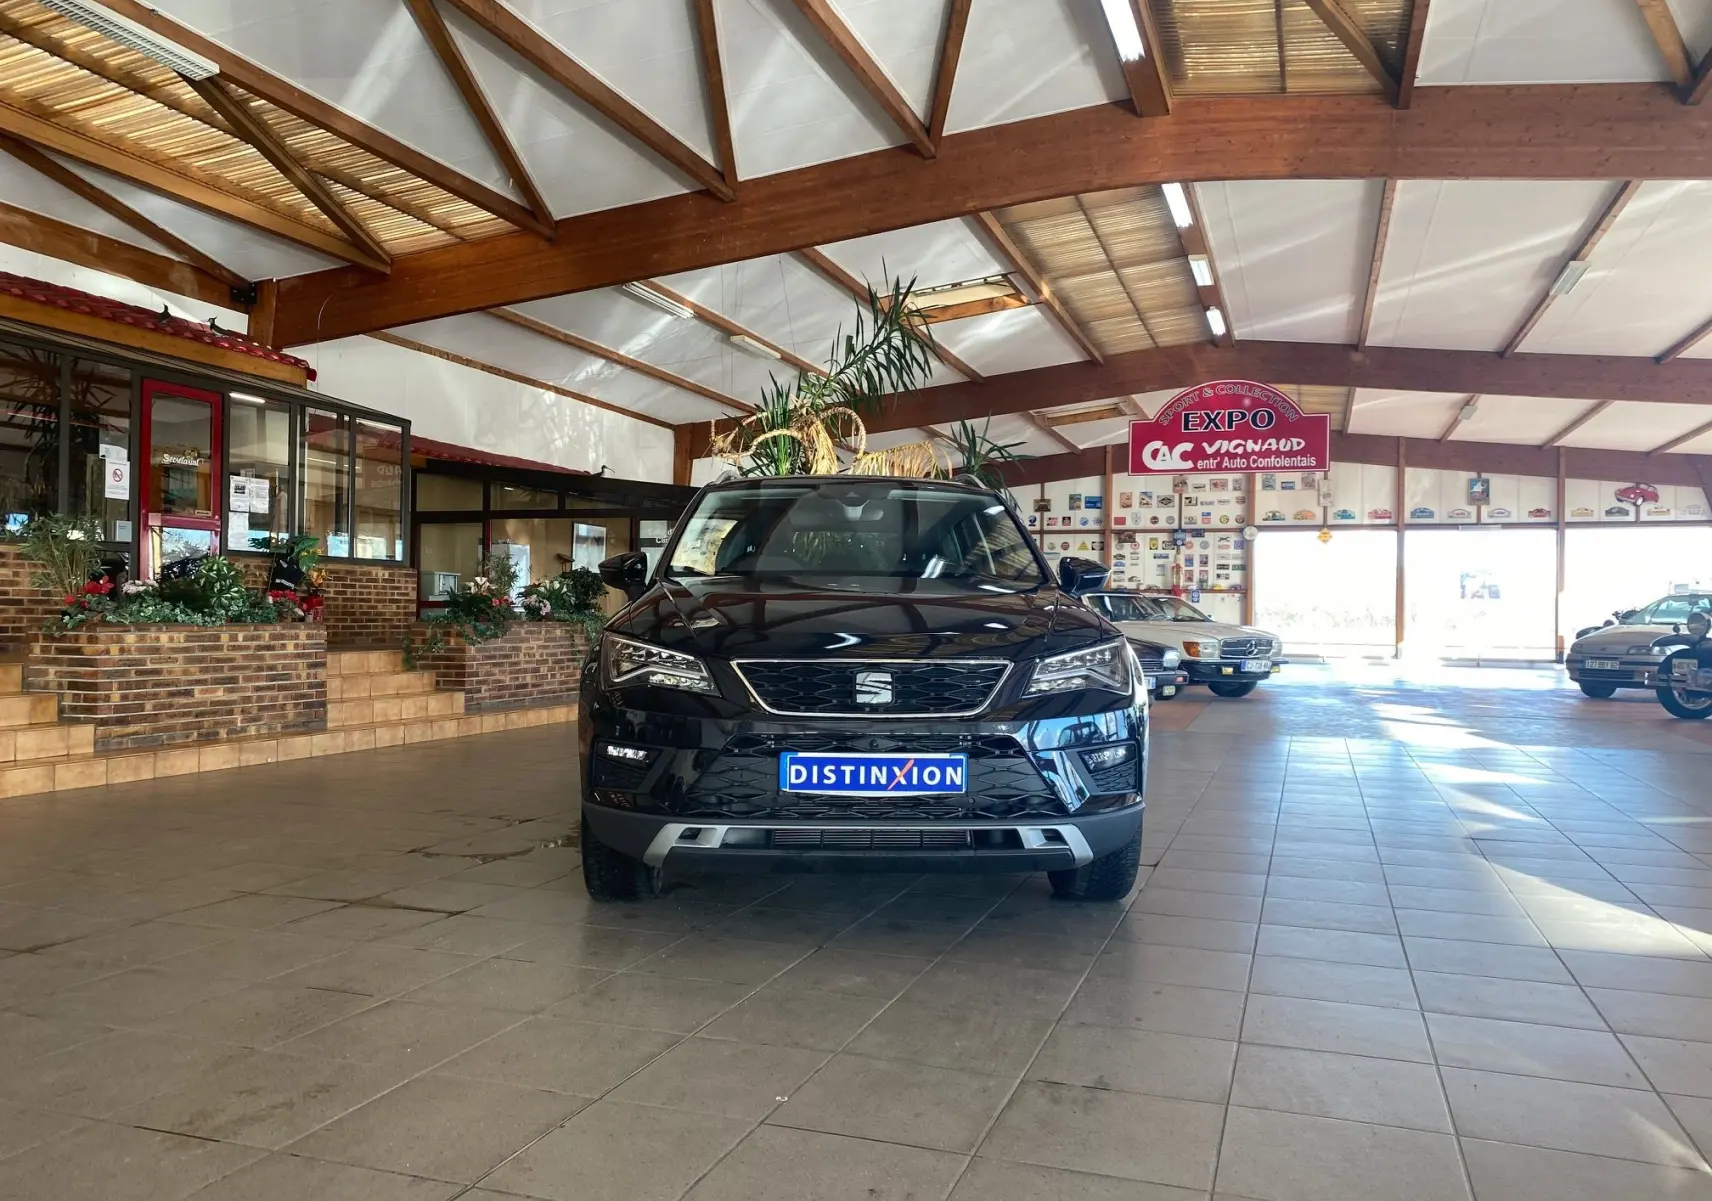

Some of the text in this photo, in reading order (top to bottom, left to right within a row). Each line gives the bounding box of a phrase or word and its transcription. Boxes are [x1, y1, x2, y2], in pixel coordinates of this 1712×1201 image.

[1159, 384, 1299, 426] SPORT & COLLECTION
[1181, 408, 1276, 432] EXPO
[1202, 437, 1306, 454] VIGNAUD
[1222, 456, 1247, 468] Auto
[1249, 454, 1317, 467] Confolentais
[790, 760, 962, 789] DISTINXION
